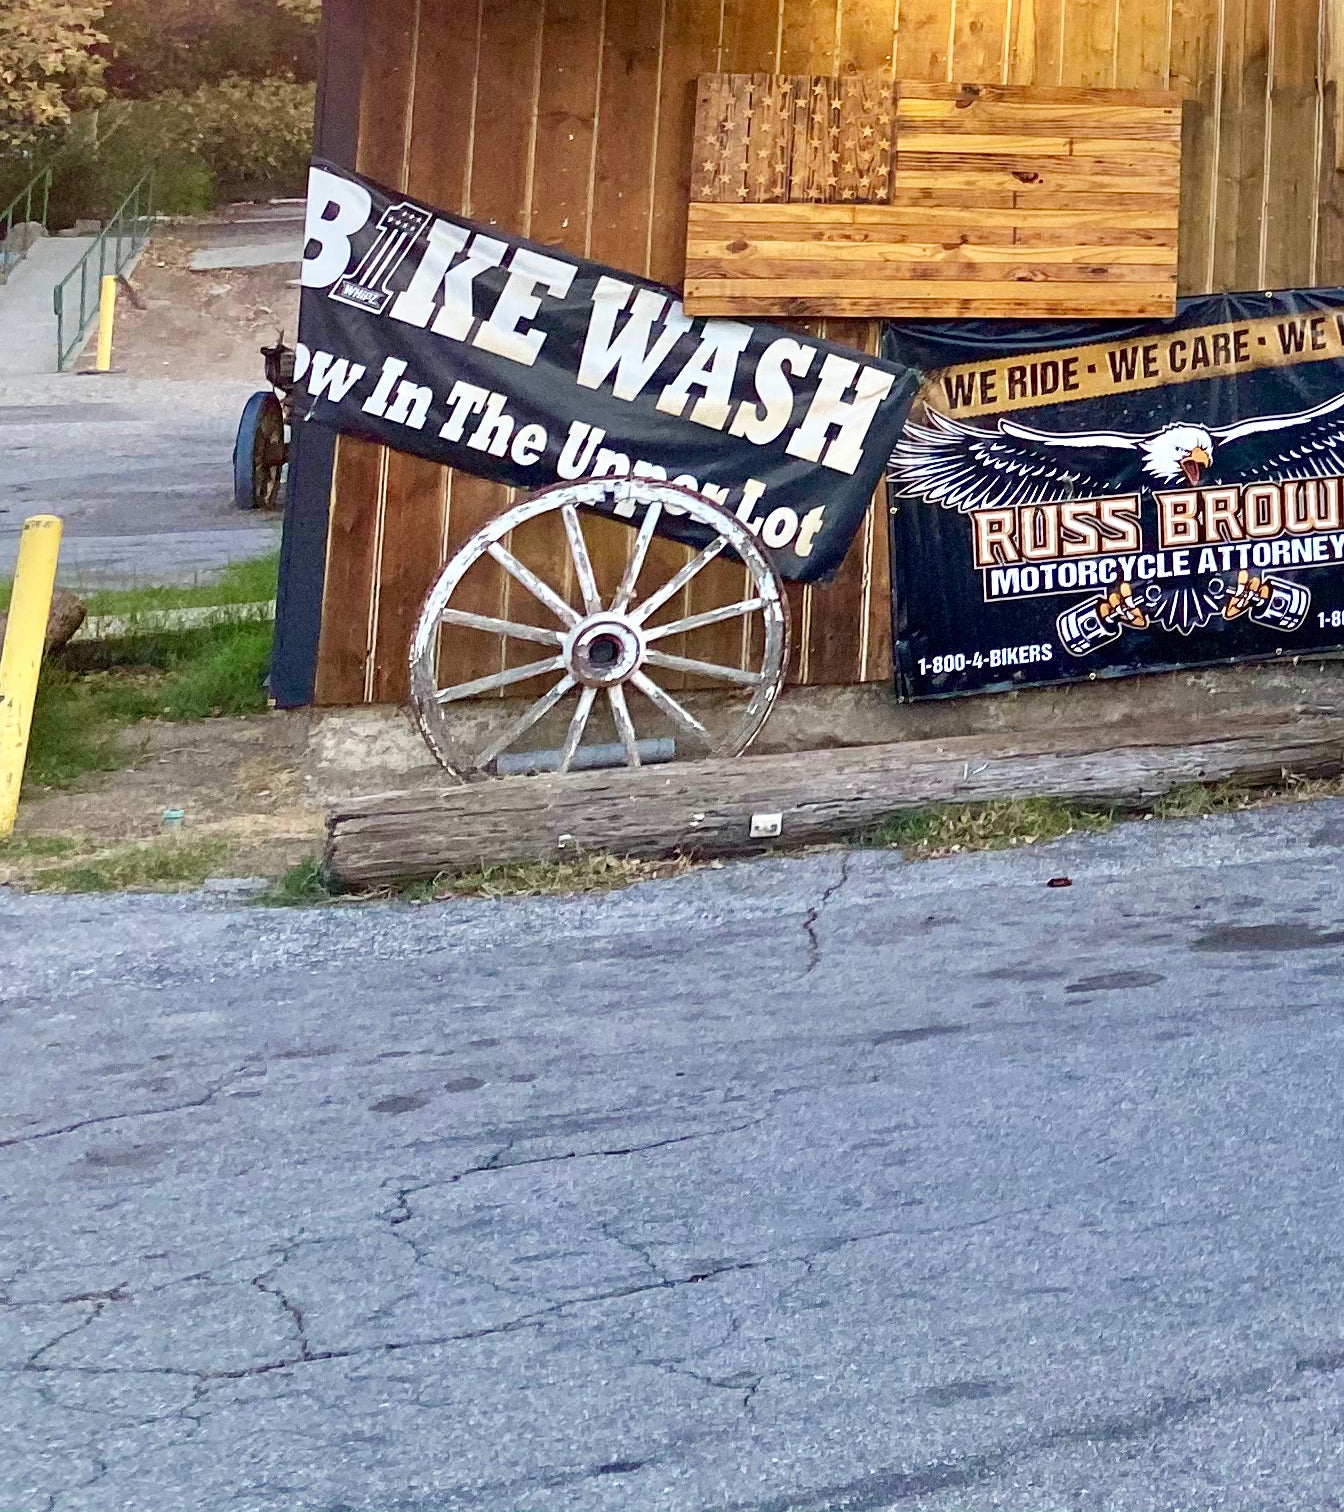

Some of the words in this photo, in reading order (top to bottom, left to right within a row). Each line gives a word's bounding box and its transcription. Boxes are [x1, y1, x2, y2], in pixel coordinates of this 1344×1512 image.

[577, 275, 896, 475] WASH
[944, 368, 999, 411] WE
[1007, 357, 1081, 402] RIDE
[1106, 342, 1160, 384] WE
[1168, 328, 1251, 372] CARE
[1274, 316, 1327, 356] WE
[361, 356, 433, 431] In
[443, 381, 549, 467] The
[735, 478, 826, 557] Lot
[973, 493, 1143, 569] RUSS
[990, 550, 1192, 597] MOTORCYCLE
[917, 642, 1054, 677] 1-800-4-BIKERS
